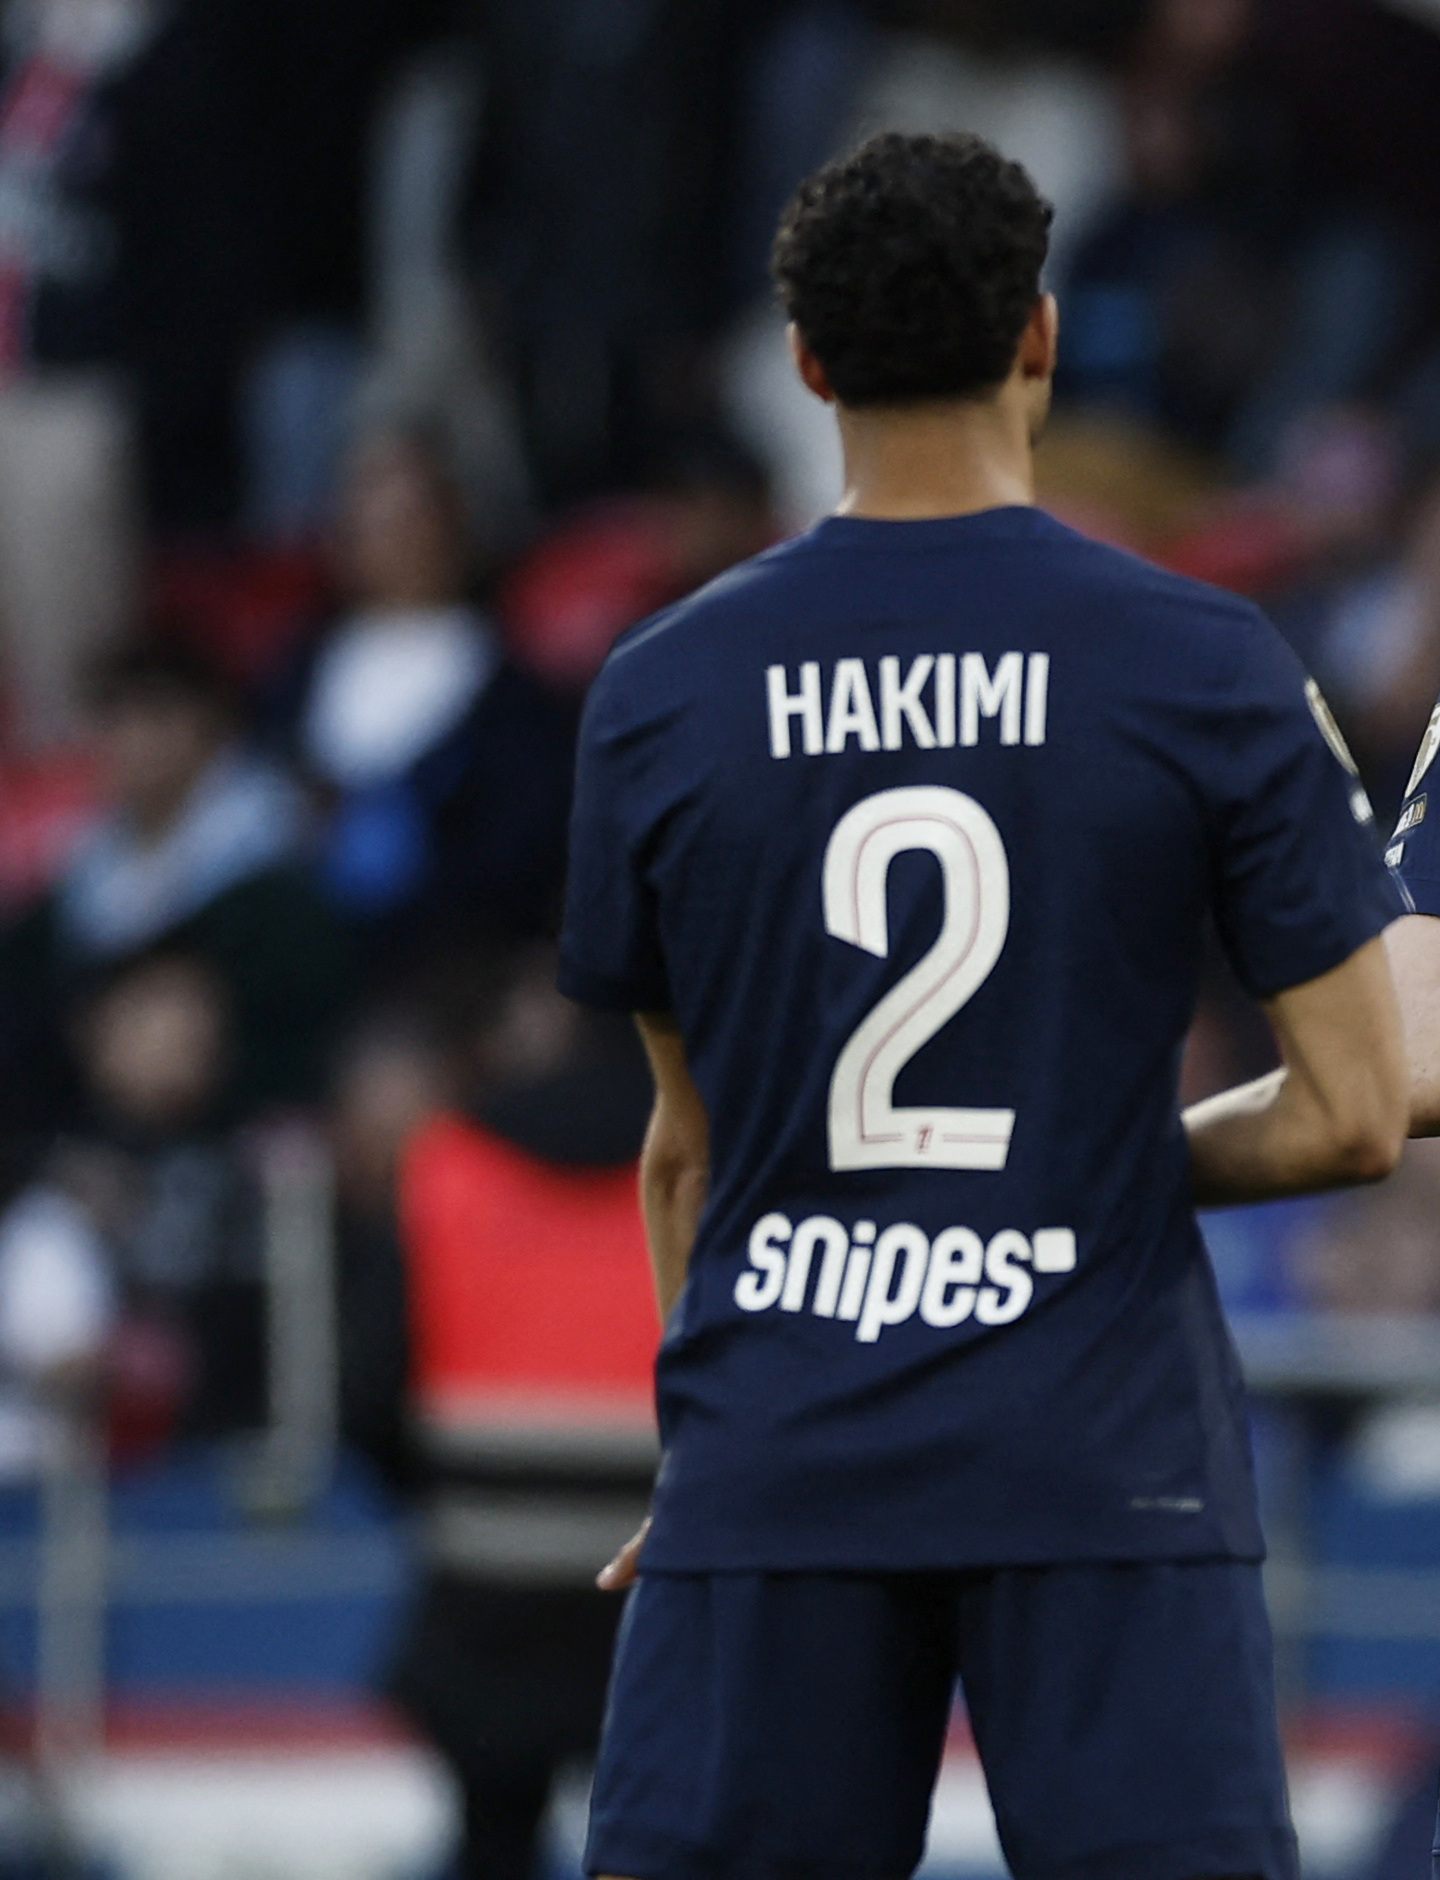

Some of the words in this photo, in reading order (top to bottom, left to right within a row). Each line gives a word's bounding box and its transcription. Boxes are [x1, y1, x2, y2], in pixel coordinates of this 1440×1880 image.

[767, 651, 1049, 759] HAKIMI
[823, 785, 1016, 1171] 2
[734, 1213, 1035, 1343] snipes
